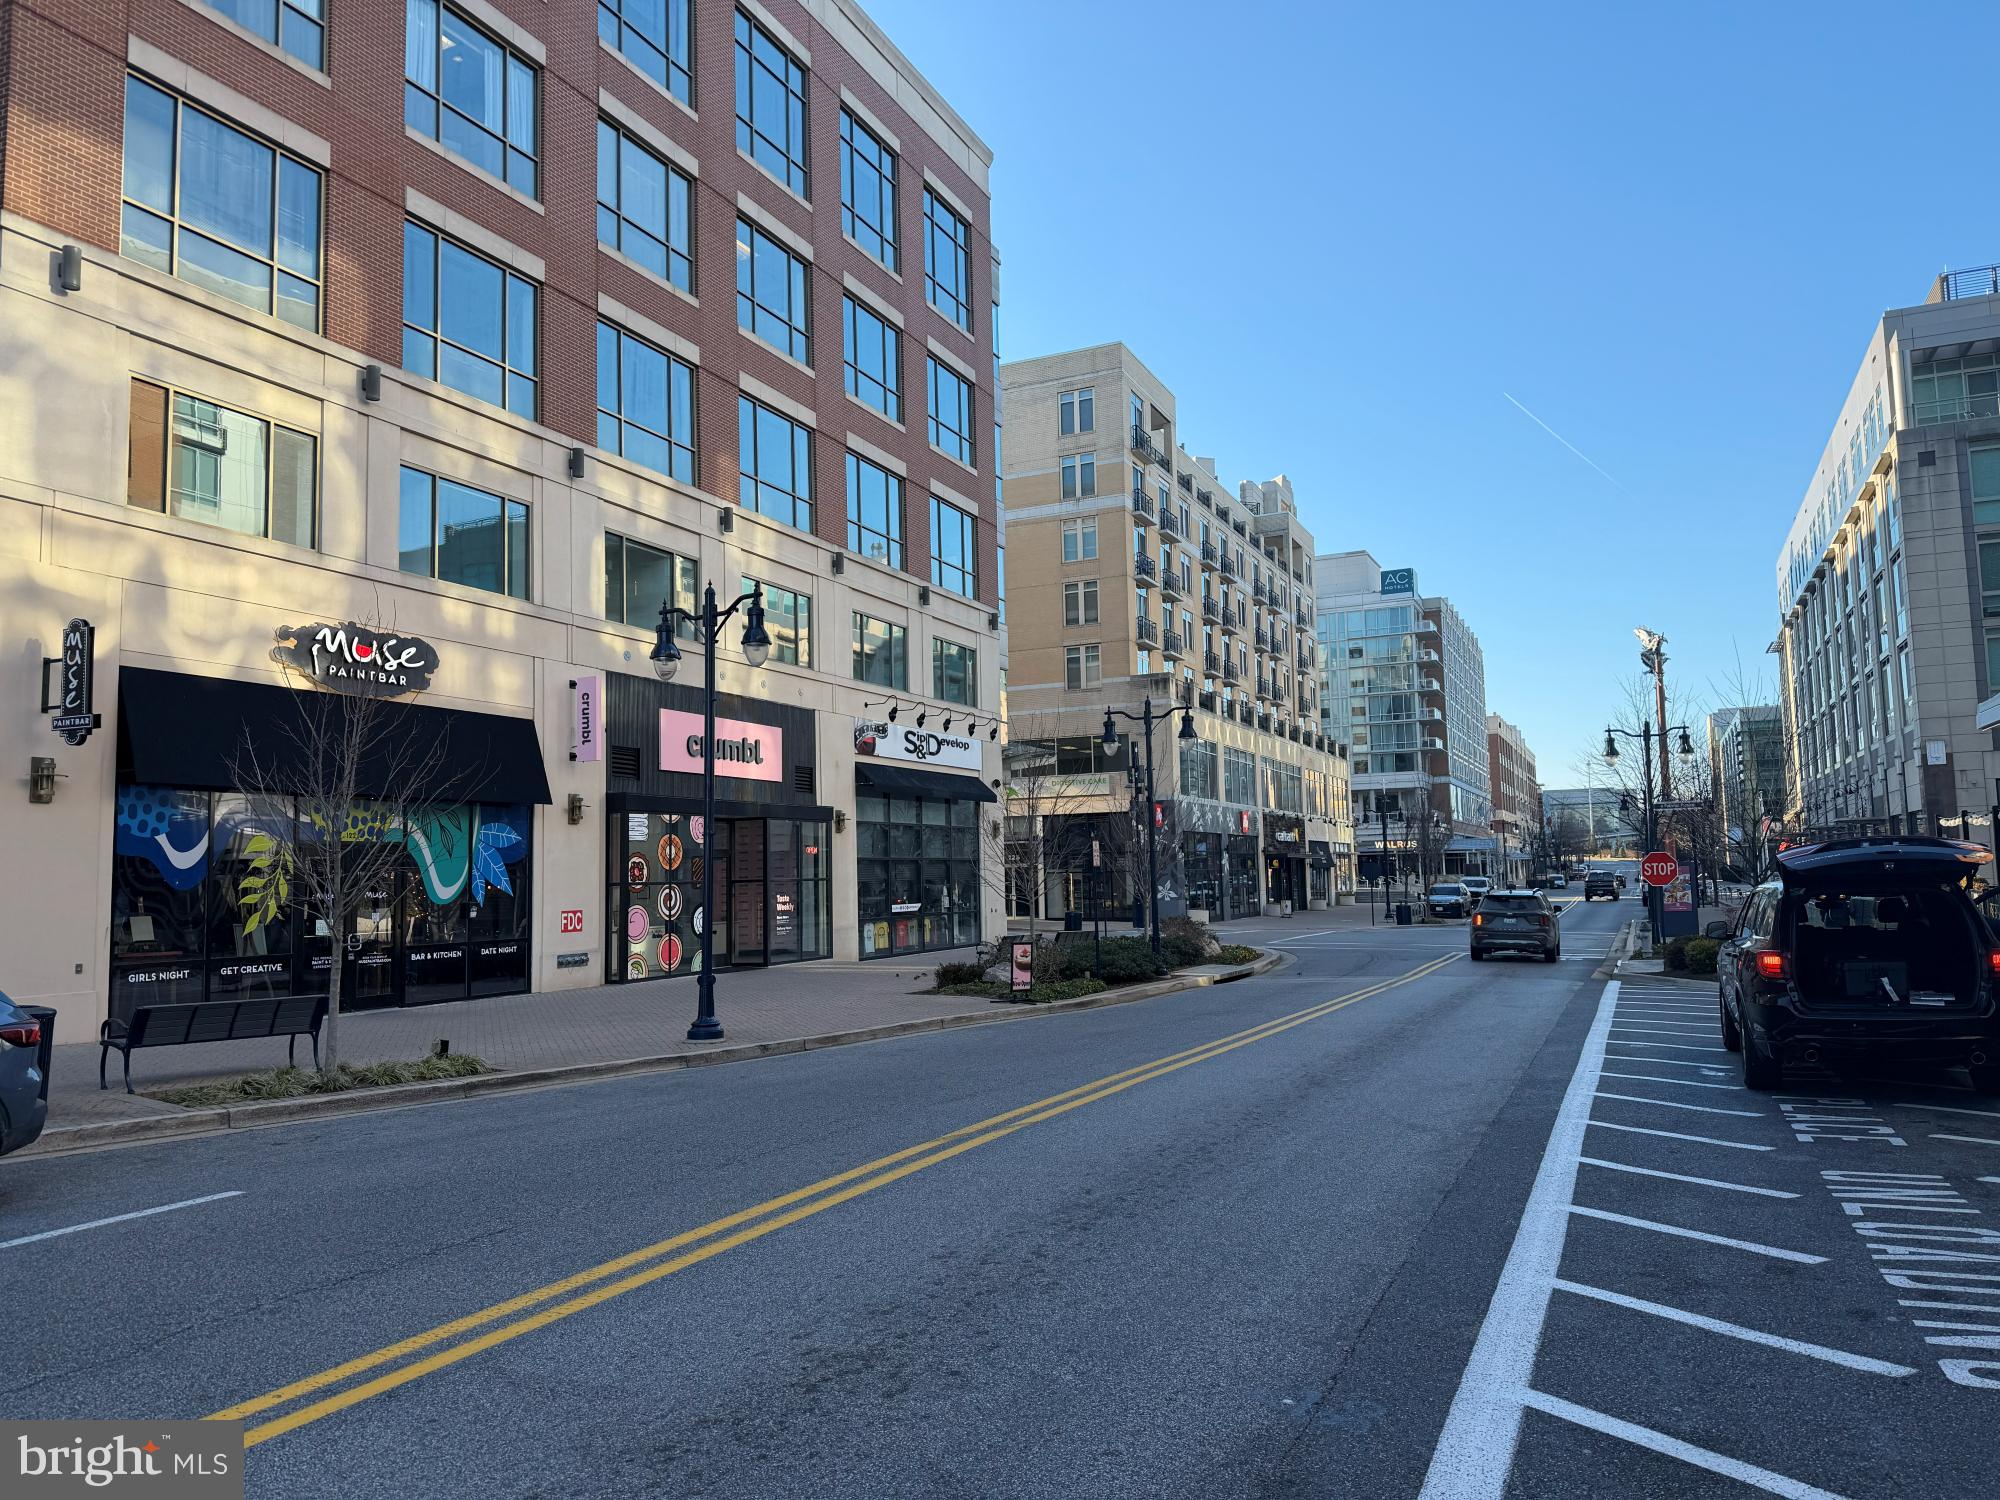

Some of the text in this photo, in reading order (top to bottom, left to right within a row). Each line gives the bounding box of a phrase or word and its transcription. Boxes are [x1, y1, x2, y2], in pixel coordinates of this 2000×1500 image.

[1385, 572, 1409, 585] AC
[329, 665, 407, 686] PAINTBAR
[53, 717, 90, 727] PAINTBAR
[581, 692, 591, 745] crumbl
[904, 730, 926, 754] Sip
[916, 745, 927, 760] &
[926, 732, 970, 757] Develop
[1088, 777, 1107, 785] CARE
[1644, 862, 1675, 876] STOP
[561, 912, 583, 931] FDC
[411, 951, 462, 961] BAR & KITCHEN
[481, 946, 518, 955] DATE NIGHT
[220, 963, 283, 975] GET CREATIVE
[128, 970, 190, 983] GIRLS NIGHT
